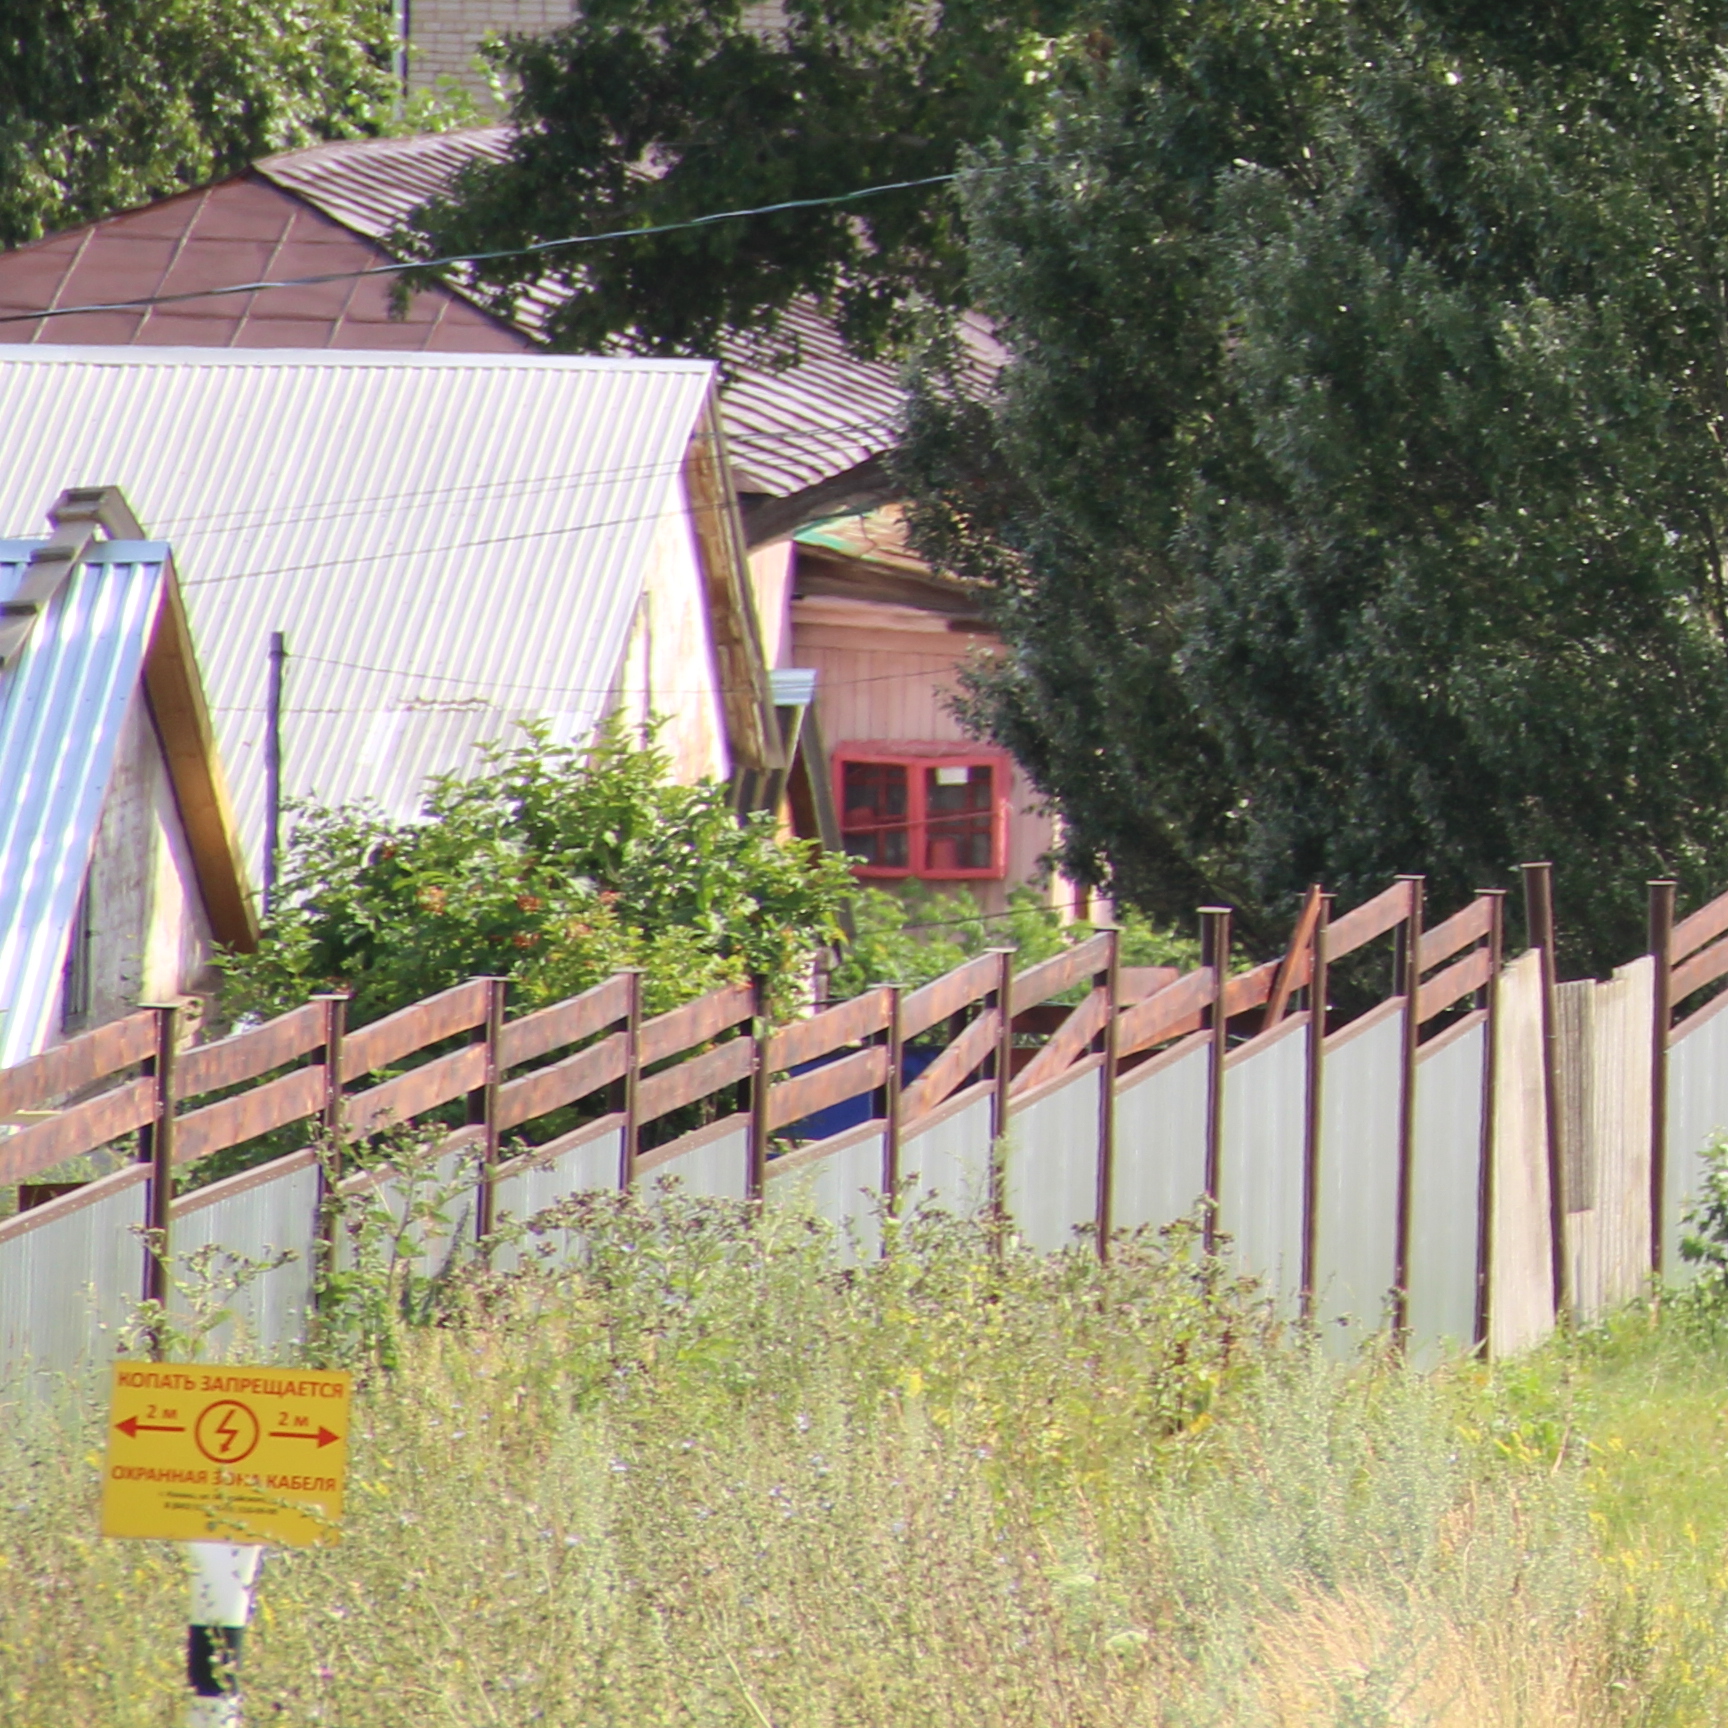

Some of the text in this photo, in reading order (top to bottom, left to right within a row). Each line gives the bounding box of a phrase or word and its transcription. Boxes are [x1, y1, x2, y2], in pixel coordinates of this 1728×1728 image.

[118, 1372, 344, 1398] КОПАТЬ ЗАПРЕЩАЕТСЯ
[146, 1404, 158, 1419] 2
[278, 1412, 289, 1426] 2
[111, 1465, 209, 1484] ОХРАННАЯ
[266, 1474, 337, 1492] КАБЕЛЯ
